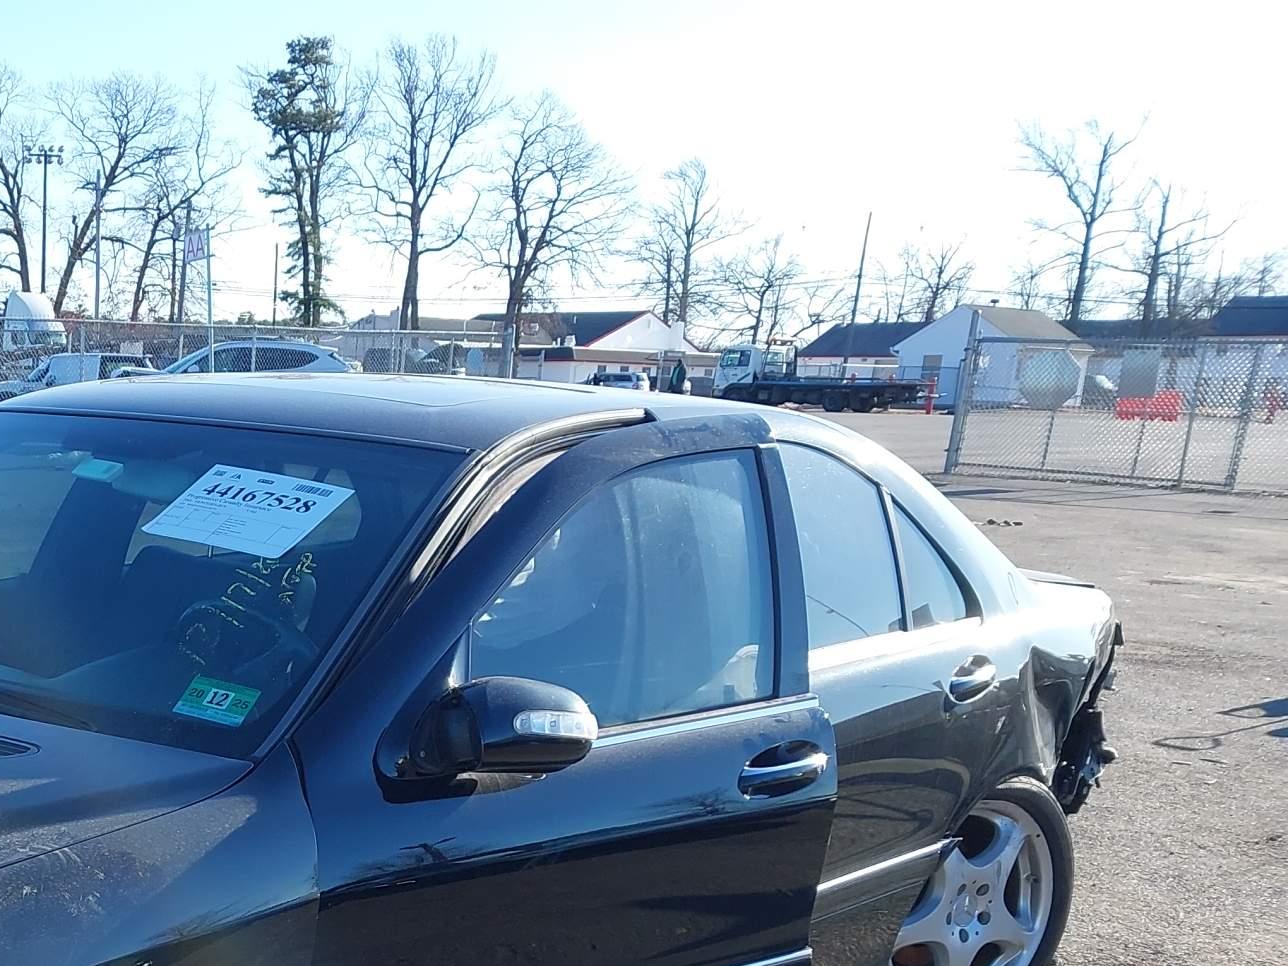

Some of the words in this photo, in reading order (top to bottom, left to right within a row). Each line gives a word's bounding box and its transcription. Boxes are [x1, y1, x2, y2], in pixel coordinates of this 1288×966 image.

[202, 482, 317, 514] 44167528
[188, 687, 205, 699] 20
[206, 690, 230, 707] 12
[232, 698, 249, 710] 25
